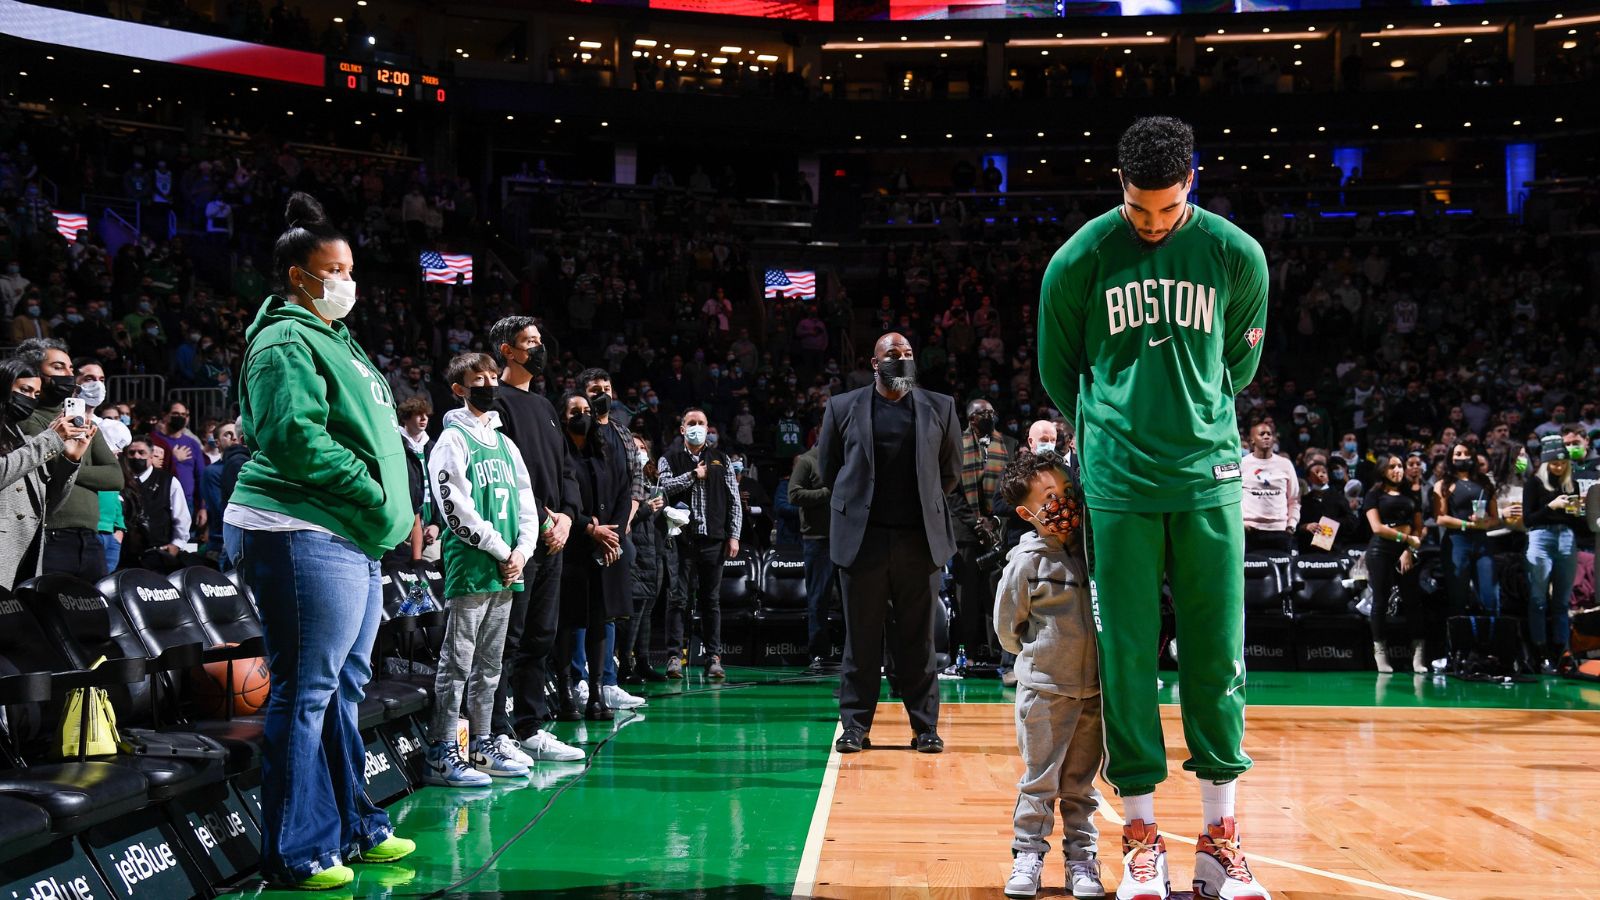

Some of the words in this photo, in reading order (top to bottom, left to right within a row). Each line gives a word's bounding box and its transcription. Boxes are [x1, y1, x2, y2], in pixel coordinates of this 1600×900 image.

[340, 62, 362, 73] CELTICS
[347, 75, 356, 89] 0
[377, 69, 410, 86] 12:00
[421, 75, 440, 85] 76ERS
[398, 88, 402, 97] 1
[437, 88, 446, 102] 0
[1105, 278, 1216, 336] BOSTON
[783, 433, 798, 444] 44
[474, 458, 516, 488] BOSTON
[494, 488, 510, 520] 7
[146, 586, 180, 601] Putnam
[208, 583, 238, 598] Putnam
[67, 594, 109, 611] Putnam
[1090, 579, 1103, 633] CELTICS
[1244, 644, 1284, 657] etBlue
[1306, 645, 1353, 660] jetBlue
[189, 811, 245, 857] jetBlue
[110, 841, 177, 896] jetBlue
